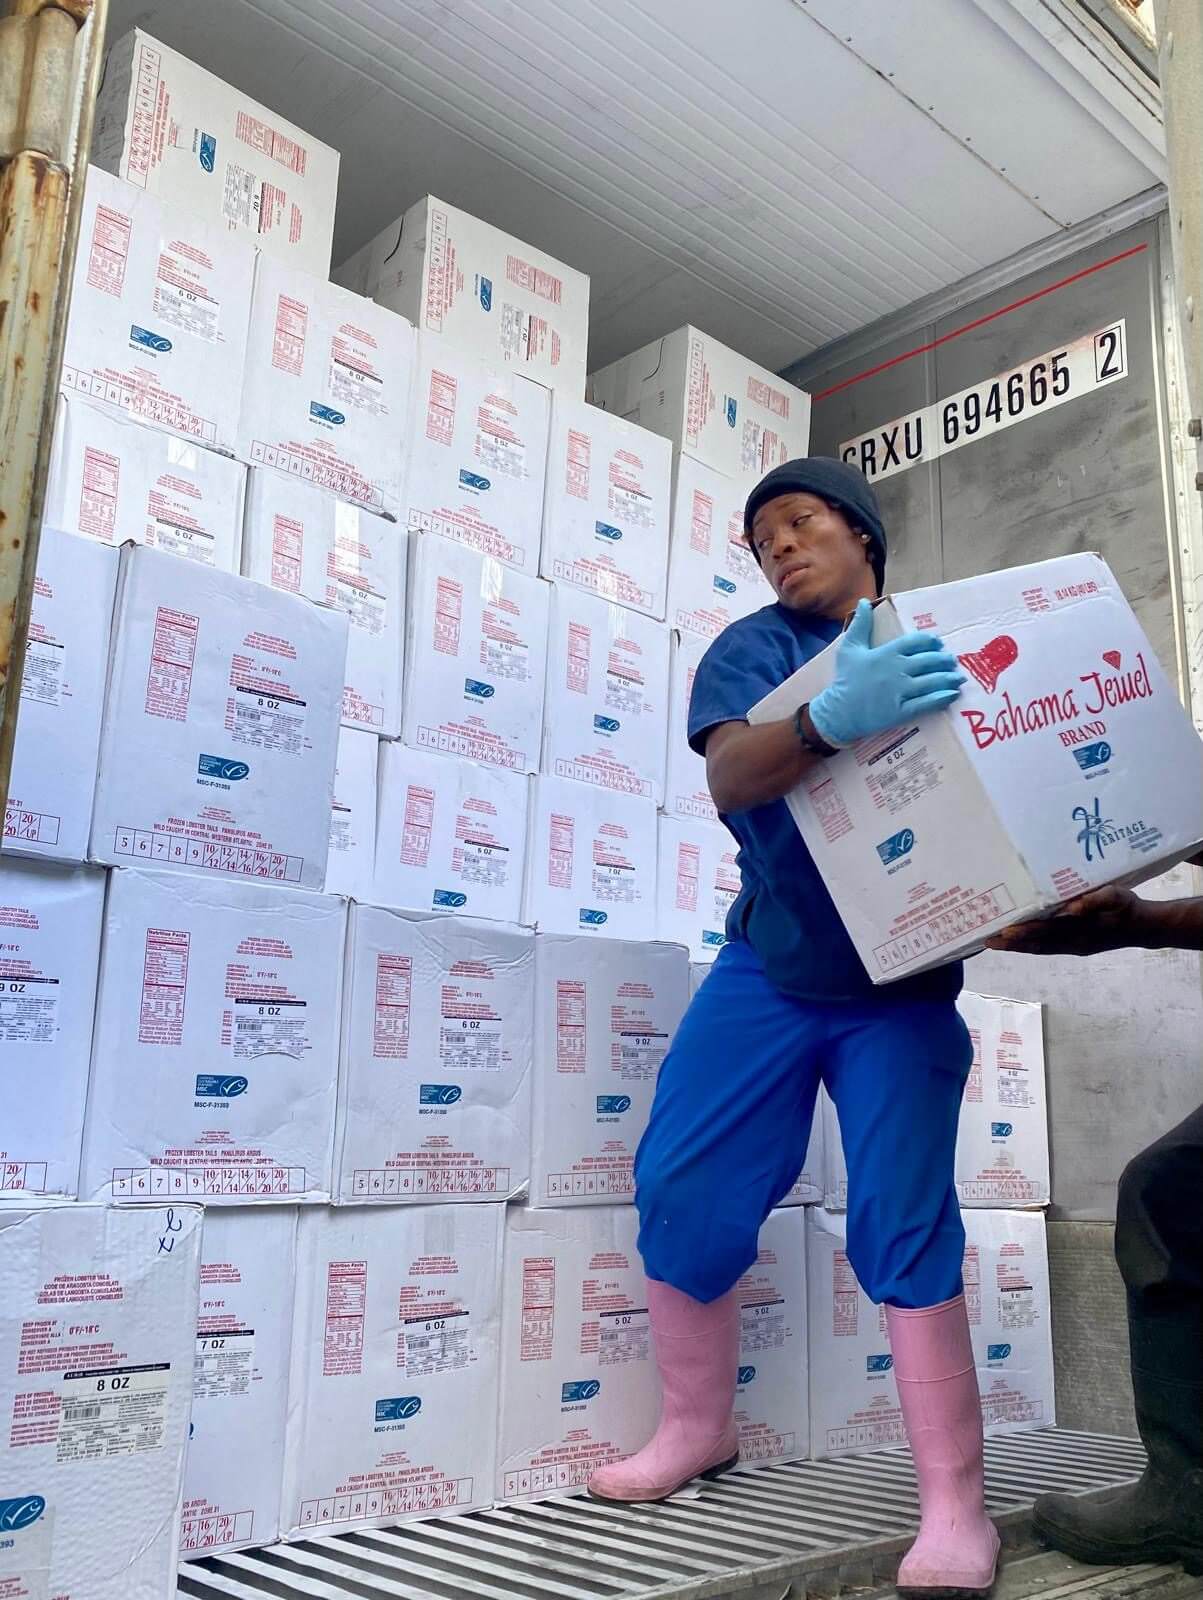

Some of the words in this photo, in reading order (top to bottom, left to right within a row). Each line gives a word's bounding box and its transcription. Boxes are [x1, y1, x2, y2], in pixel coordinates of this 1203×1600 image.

[178, 289, 184, 297] 6
[186, 293, 197, 302] OZ
[355, 374, 365, 382] OZ
[66, 373, 72, 382] 5
[81, 379, 87, 388] 6
[110, 390, 116, 399] 8
[124, 395, 130, 404] 9
[943, 352, 1071, 444] 694665
[1099, 332, 1118, 379] 2
[256, 448, 261, 456] 5
[175, 529, 181, 537] 6
[182, 532, 193, 541] OZ
[258, 698, 264, 706] 8
[267, 700, 280, 709] OZ
[961, 688, 1080, 749] Bahama
[1080, 652, 1153, 714] Jewel
[1057, 720, 1107, 747] BRAND
[420, 733, 425, 741] 5
[461, 743, 466, 751] 9
[894, 747, 905, 761] OZ
[121, 837, 128, 848] 5
[139, 841, 146, 851] 6
[157, 844, 164, 852] 7
[175, 846, 182, 856] 8
[192, 849, 199, 859] 9
[10, 983, 26, 993] OZ
[258, 1006, 264, 1015] 8
[267, 1007, 281, 1016] OZ
[462, 1021, 468, 1029] 6
[470, 1021, 480, 1029] OZ
[642, 1038, 651, 1046] OZ
[165, 1149, 183, 1157] FROZEN
[183, 1149, 204, 1157] LOBSTER
[205, 1149, 217, 1157] TAILS
[119, 1179, 126, 1188] 5
[138, 1178, 145, 1188] 6
[156, 1178, 163, 1188] 7
[175, 1178, 181, 1187] 8
[192, 1178, 199, 1187] 9
[359, 1180, 364, 1188] 5
[374, 1179, 379, 1187] 6
[388, 1179, 395, 1188] 7
[404, 1178, 409, 1187] 8
[418, 1178, 424, 1187] 9
[552, 1183, 557, 1191] 5
[564, 1182, 570, 1190] 6
[576, 1181, 582, 1189] 7
[761, 1306, 769, 1314] OZ
[425, 1323, 431, 1331] 6
[434, 1320, 446, 1330] OZ
[615, 1317, 620, 1325] 5
[622, 1316, 632, 1324] OZ
[201, 1340, 207, 1350] 7
[211, 1339, 225, 1348] OZ
[96, 1379, 105, 1391] 8
[111, 1377, 130, 1391] OZ
[509, 1480, 514, 1490] 5
[522, 1479, 527, 1488] 6
[560, 1472, 566, 1481] 9
[305, 1511, 312, 1521] 5
[322, 1508, 329, 1518] 6
[339, 1505, 345, 1515] 7
[355, 1503, 361, 1513] 8
[371, 1501, 377, 1510] 9
